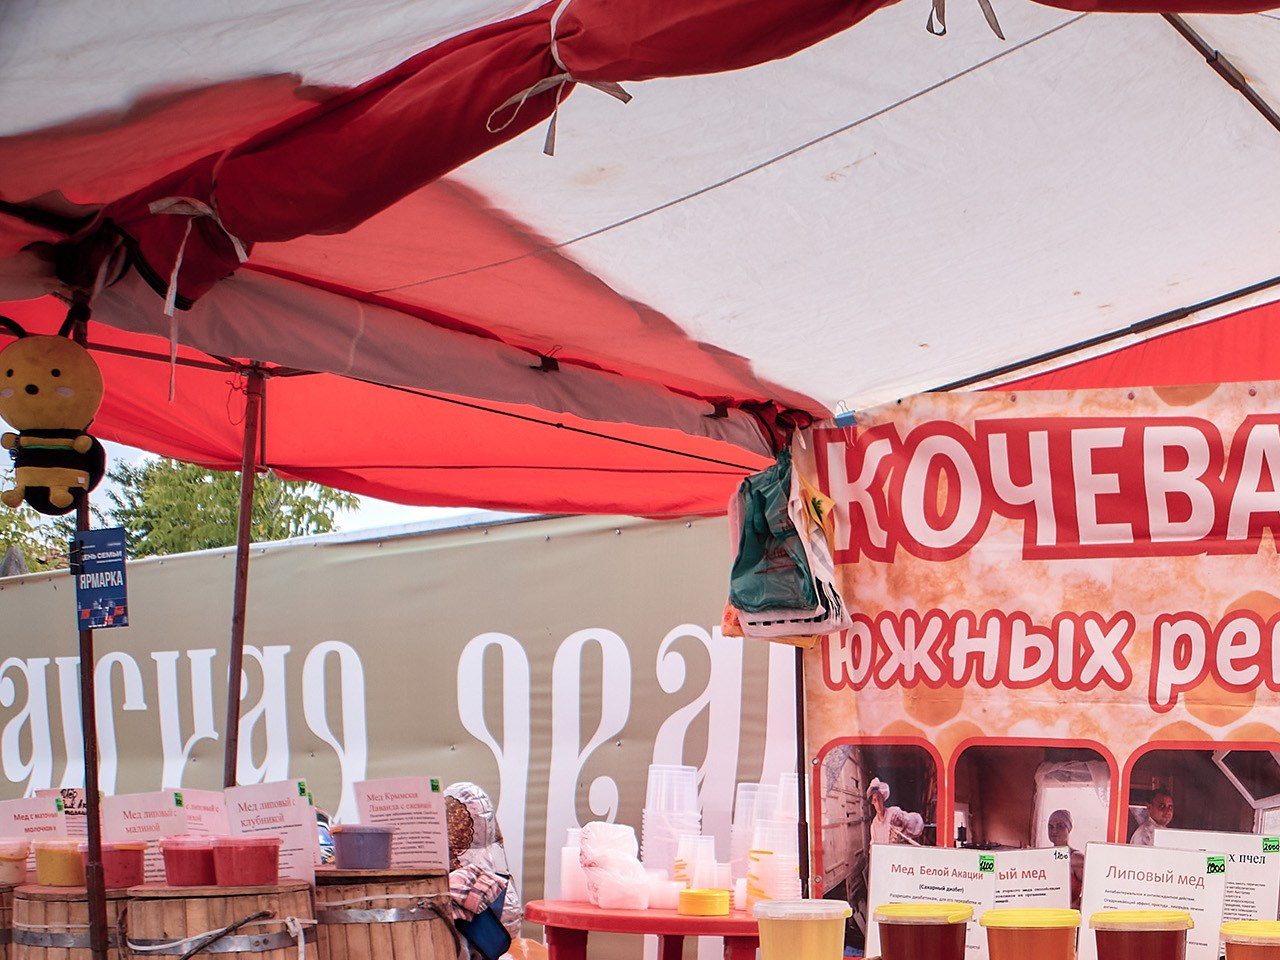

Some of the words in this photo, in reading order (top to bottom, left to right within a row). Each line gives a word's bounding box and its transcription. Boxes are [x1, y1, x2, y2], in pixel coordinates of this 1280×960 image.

[80, 570, 124, 590] ЯРМАРКА
[827, 616, 1132, 686] южных
[238, 802, 258, 813] Мед
[259, 797, 291, 810] липовый
[14, 813, 30, 822] Мед
[123, 810, 142, 820] Мед
[143, 807, 172, 819] липовый
[240, 813, 285, 828] клубникой
[125, 823, 161, 834] малиной
[1239, 854, 1266, 864] пчел
[891, 863, 915, 877] Мед
[919, 865, 949, 877] Белой
[951, 868, 984, 881] Акации
[1021, 869, 1047, 880] мед
[1105, 865, 1174, 884] Липовый
[1177, 874, 1205, 889] мед
